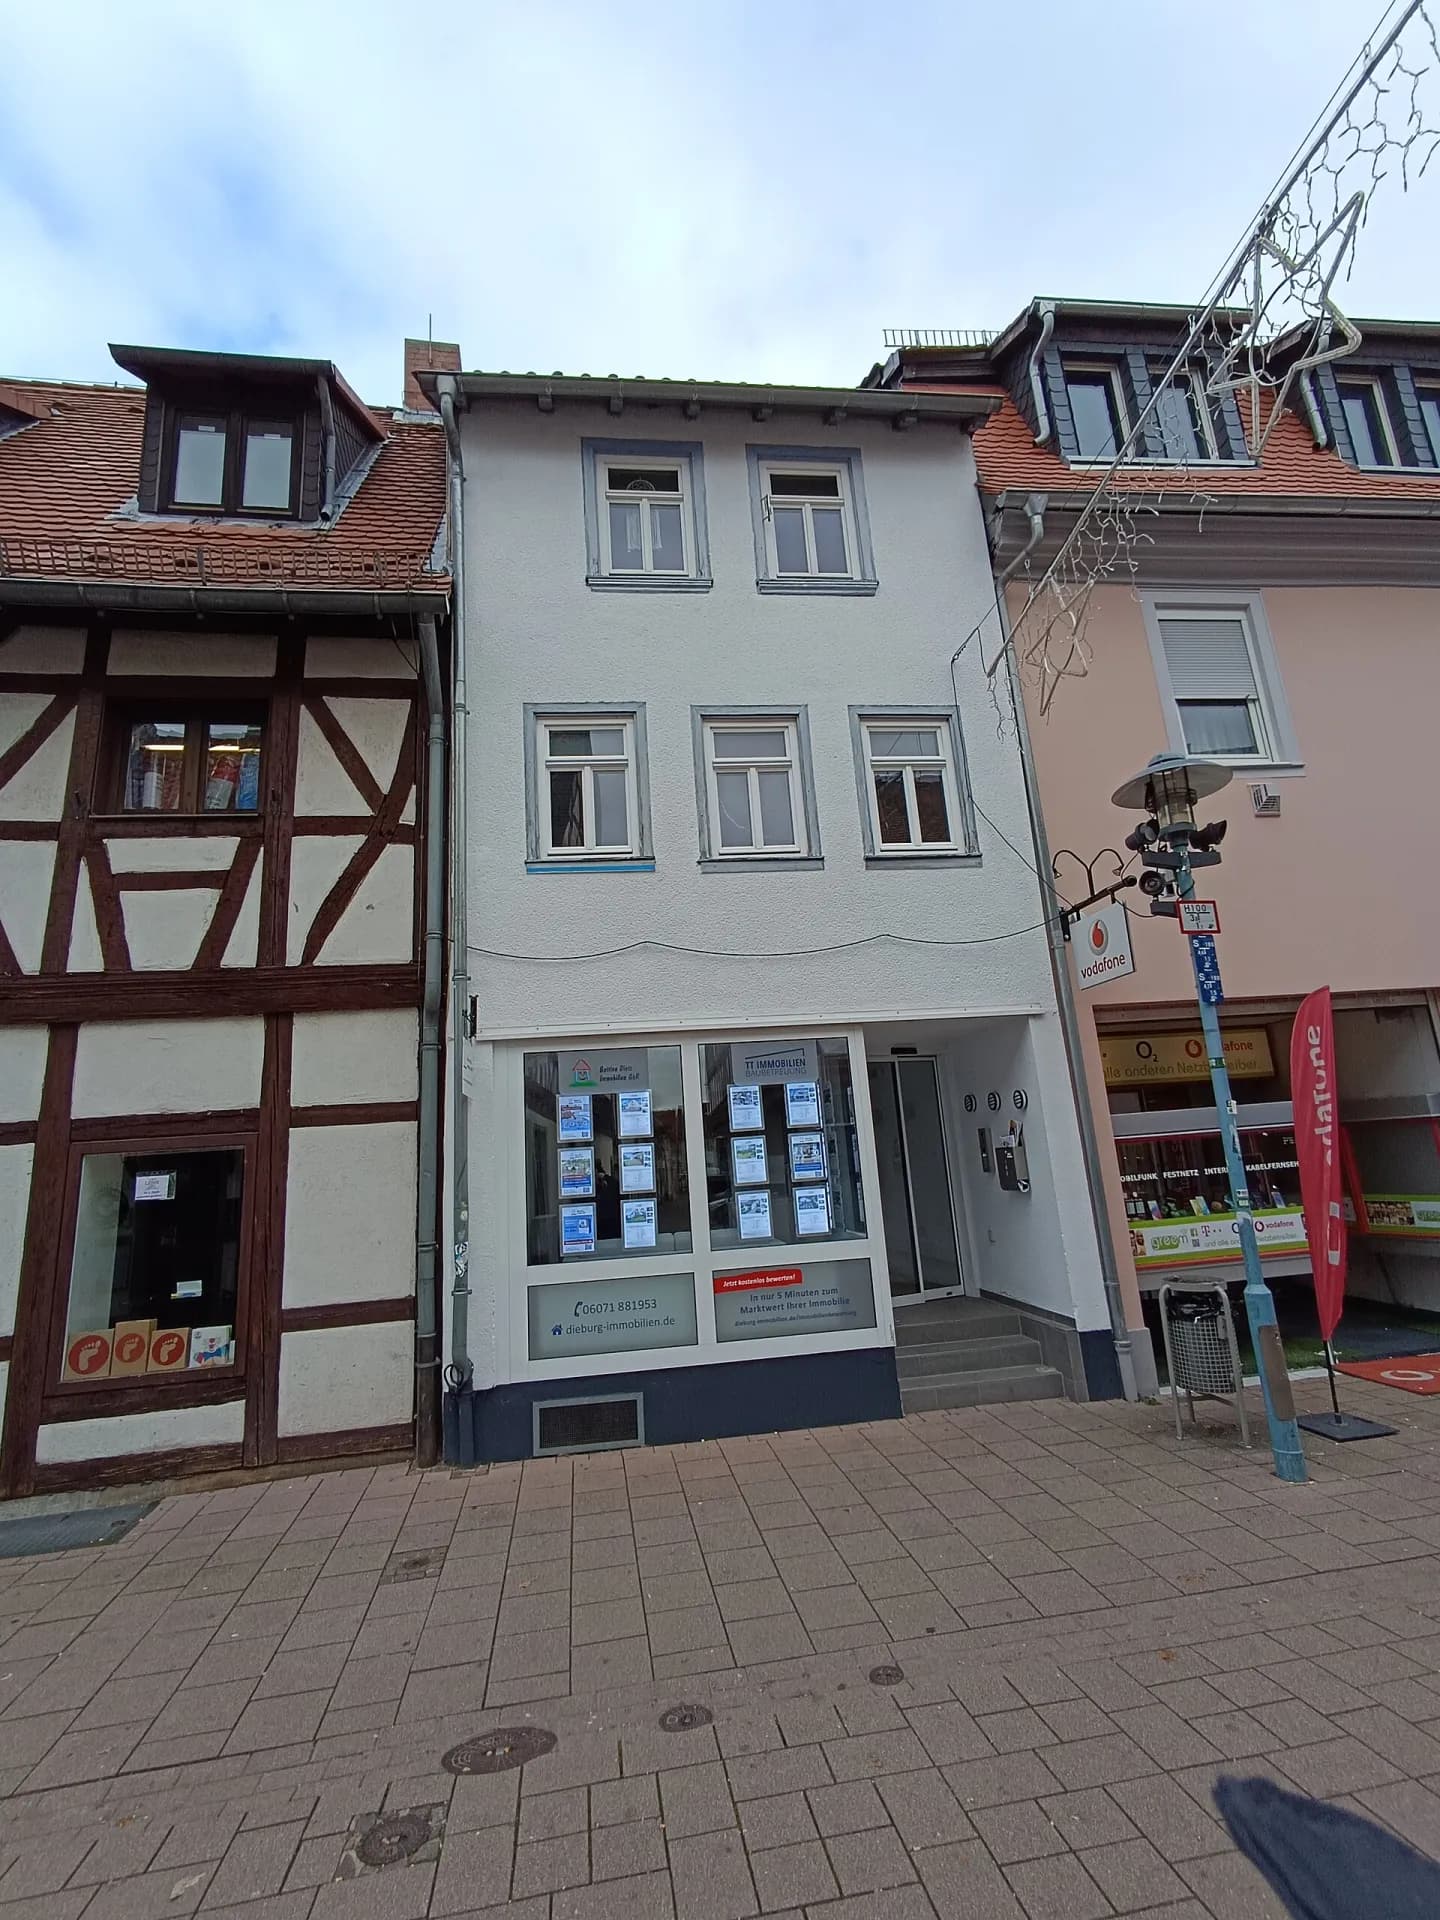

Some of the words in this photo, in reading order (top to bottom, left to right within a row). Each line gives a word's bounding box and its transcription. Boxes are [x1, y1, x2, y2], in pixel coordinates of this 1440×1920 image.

[1184, 904, 1207, 913] H100
[1081, 954, 1126, 979] vodafone
[745, 1061, 754, 1070] TT
[756, 1058, 806, 1070] IMMOBILIEN
[1120, 1173, 1158, 1183] OBILFUNK
[1163, 1169, 1200, 1179] FESTNETZ
[1204, 1167, 1229, 1176] INTER
[1245, 1160, 1300, 1172] KABELFERNSEH
[723, 1280, 738, 1288] Jetzt
[738, 1277, 765, 1286] kostenlos
[765, 1273, 796, 1283] bewerten!
[750, 1294, 758, 1302] In
[760, 1292, 775, 1301] nur
[777, 1291, 782, 1299] 5
[784, 1289, 819, 1299] Minuten
[821, 1287, 839, 1295] zum
[582, 1303, 615, 1315] 06071
[617, 1299, 657, 1312] 881953
[740, 1304, 785, 1314] Marktwert
[786, 1301, 807, 1310] Ihrer
[808, 1297, 850, 1308] Immobilie
[565, 1315, 676, 1335] dieburg-immobilien.de
